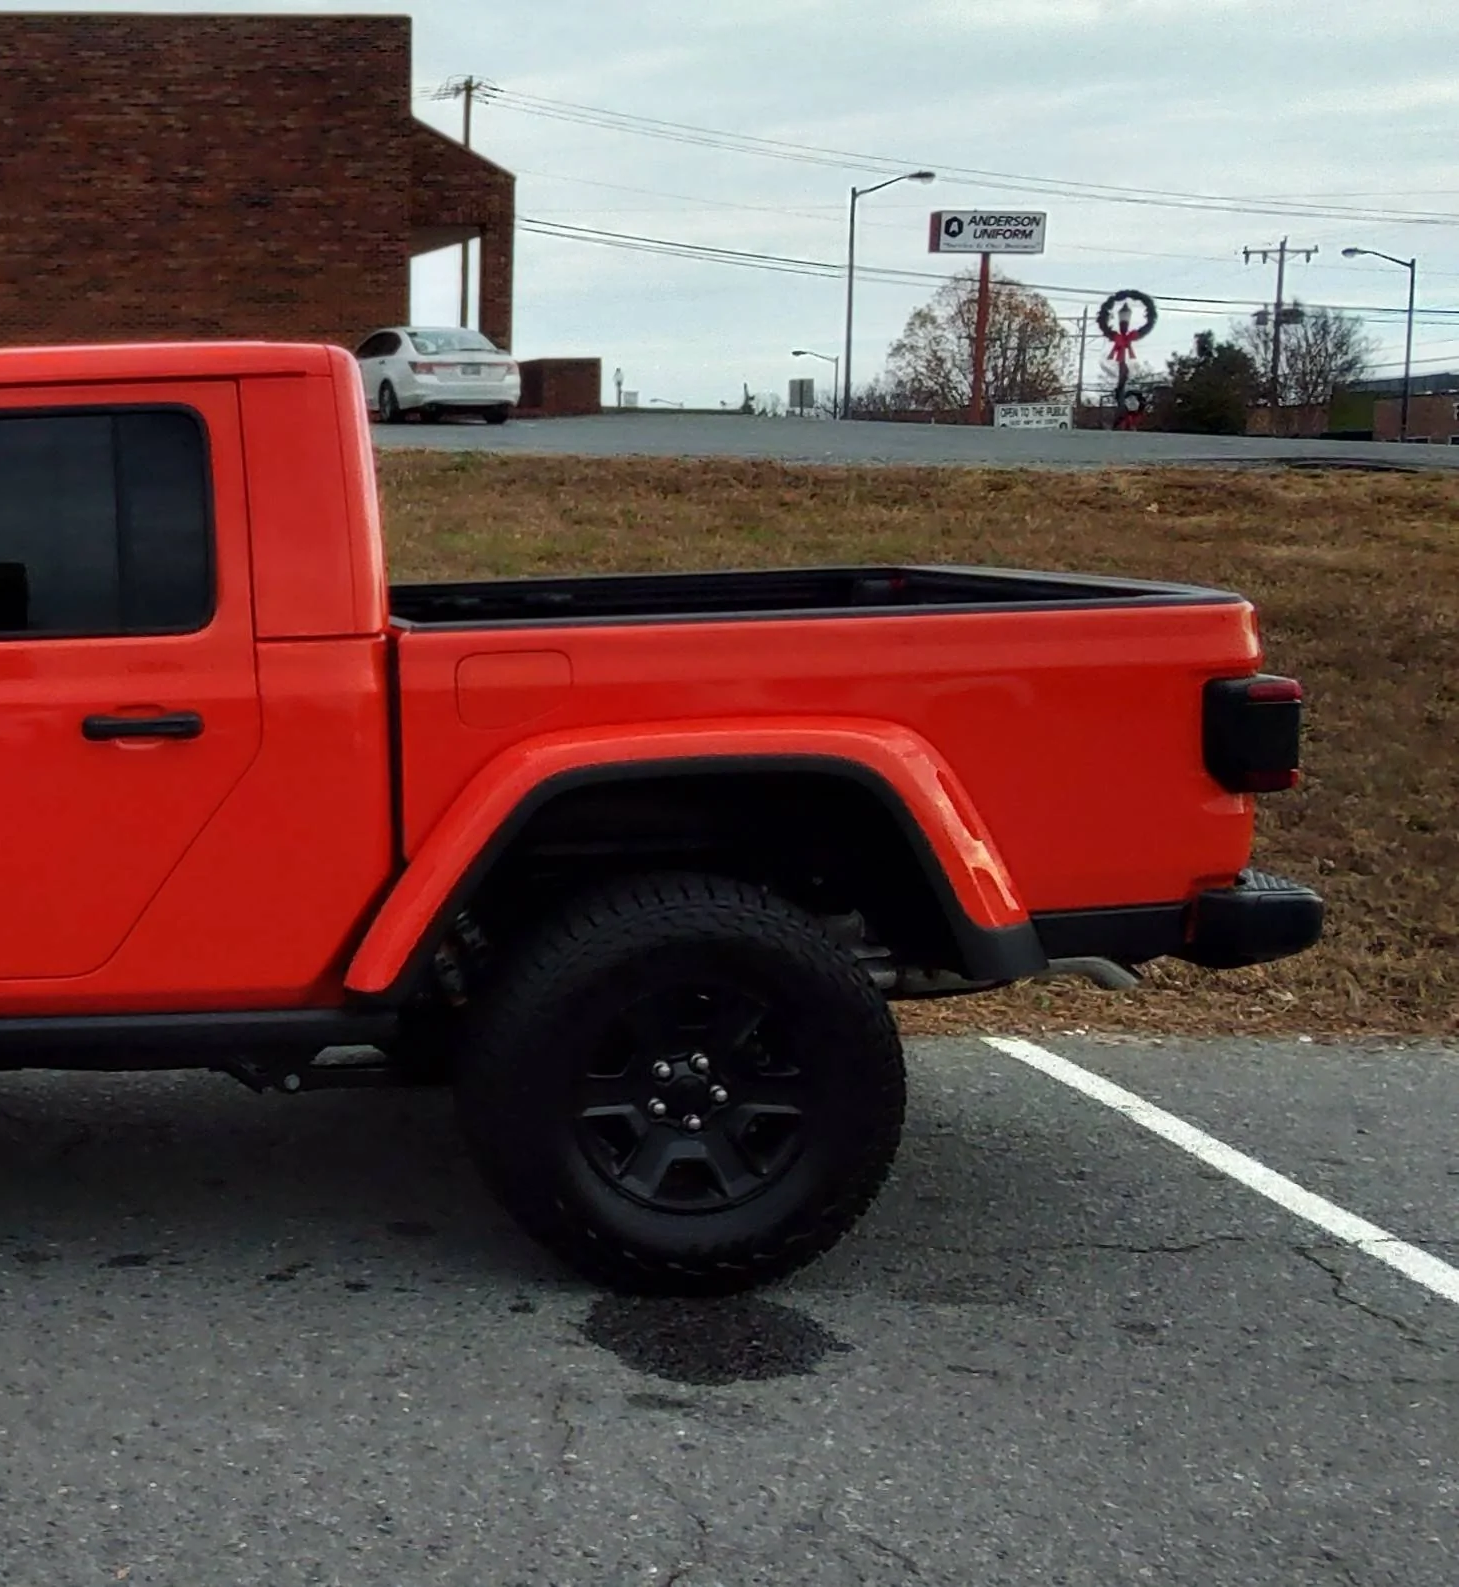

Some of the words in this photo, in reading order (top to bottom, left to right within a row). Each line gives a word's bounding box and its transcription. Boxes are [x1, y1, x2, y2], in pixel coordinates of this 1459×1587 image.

[968, 215, 1040, 227] ANDERSON
[973, 228, 1033, 239] UNIFORM
[1000, 407, 1018, 417] OPEN
[1020, 407, 1029, 417] TO
[1031, 407, 1044, 416] THE
